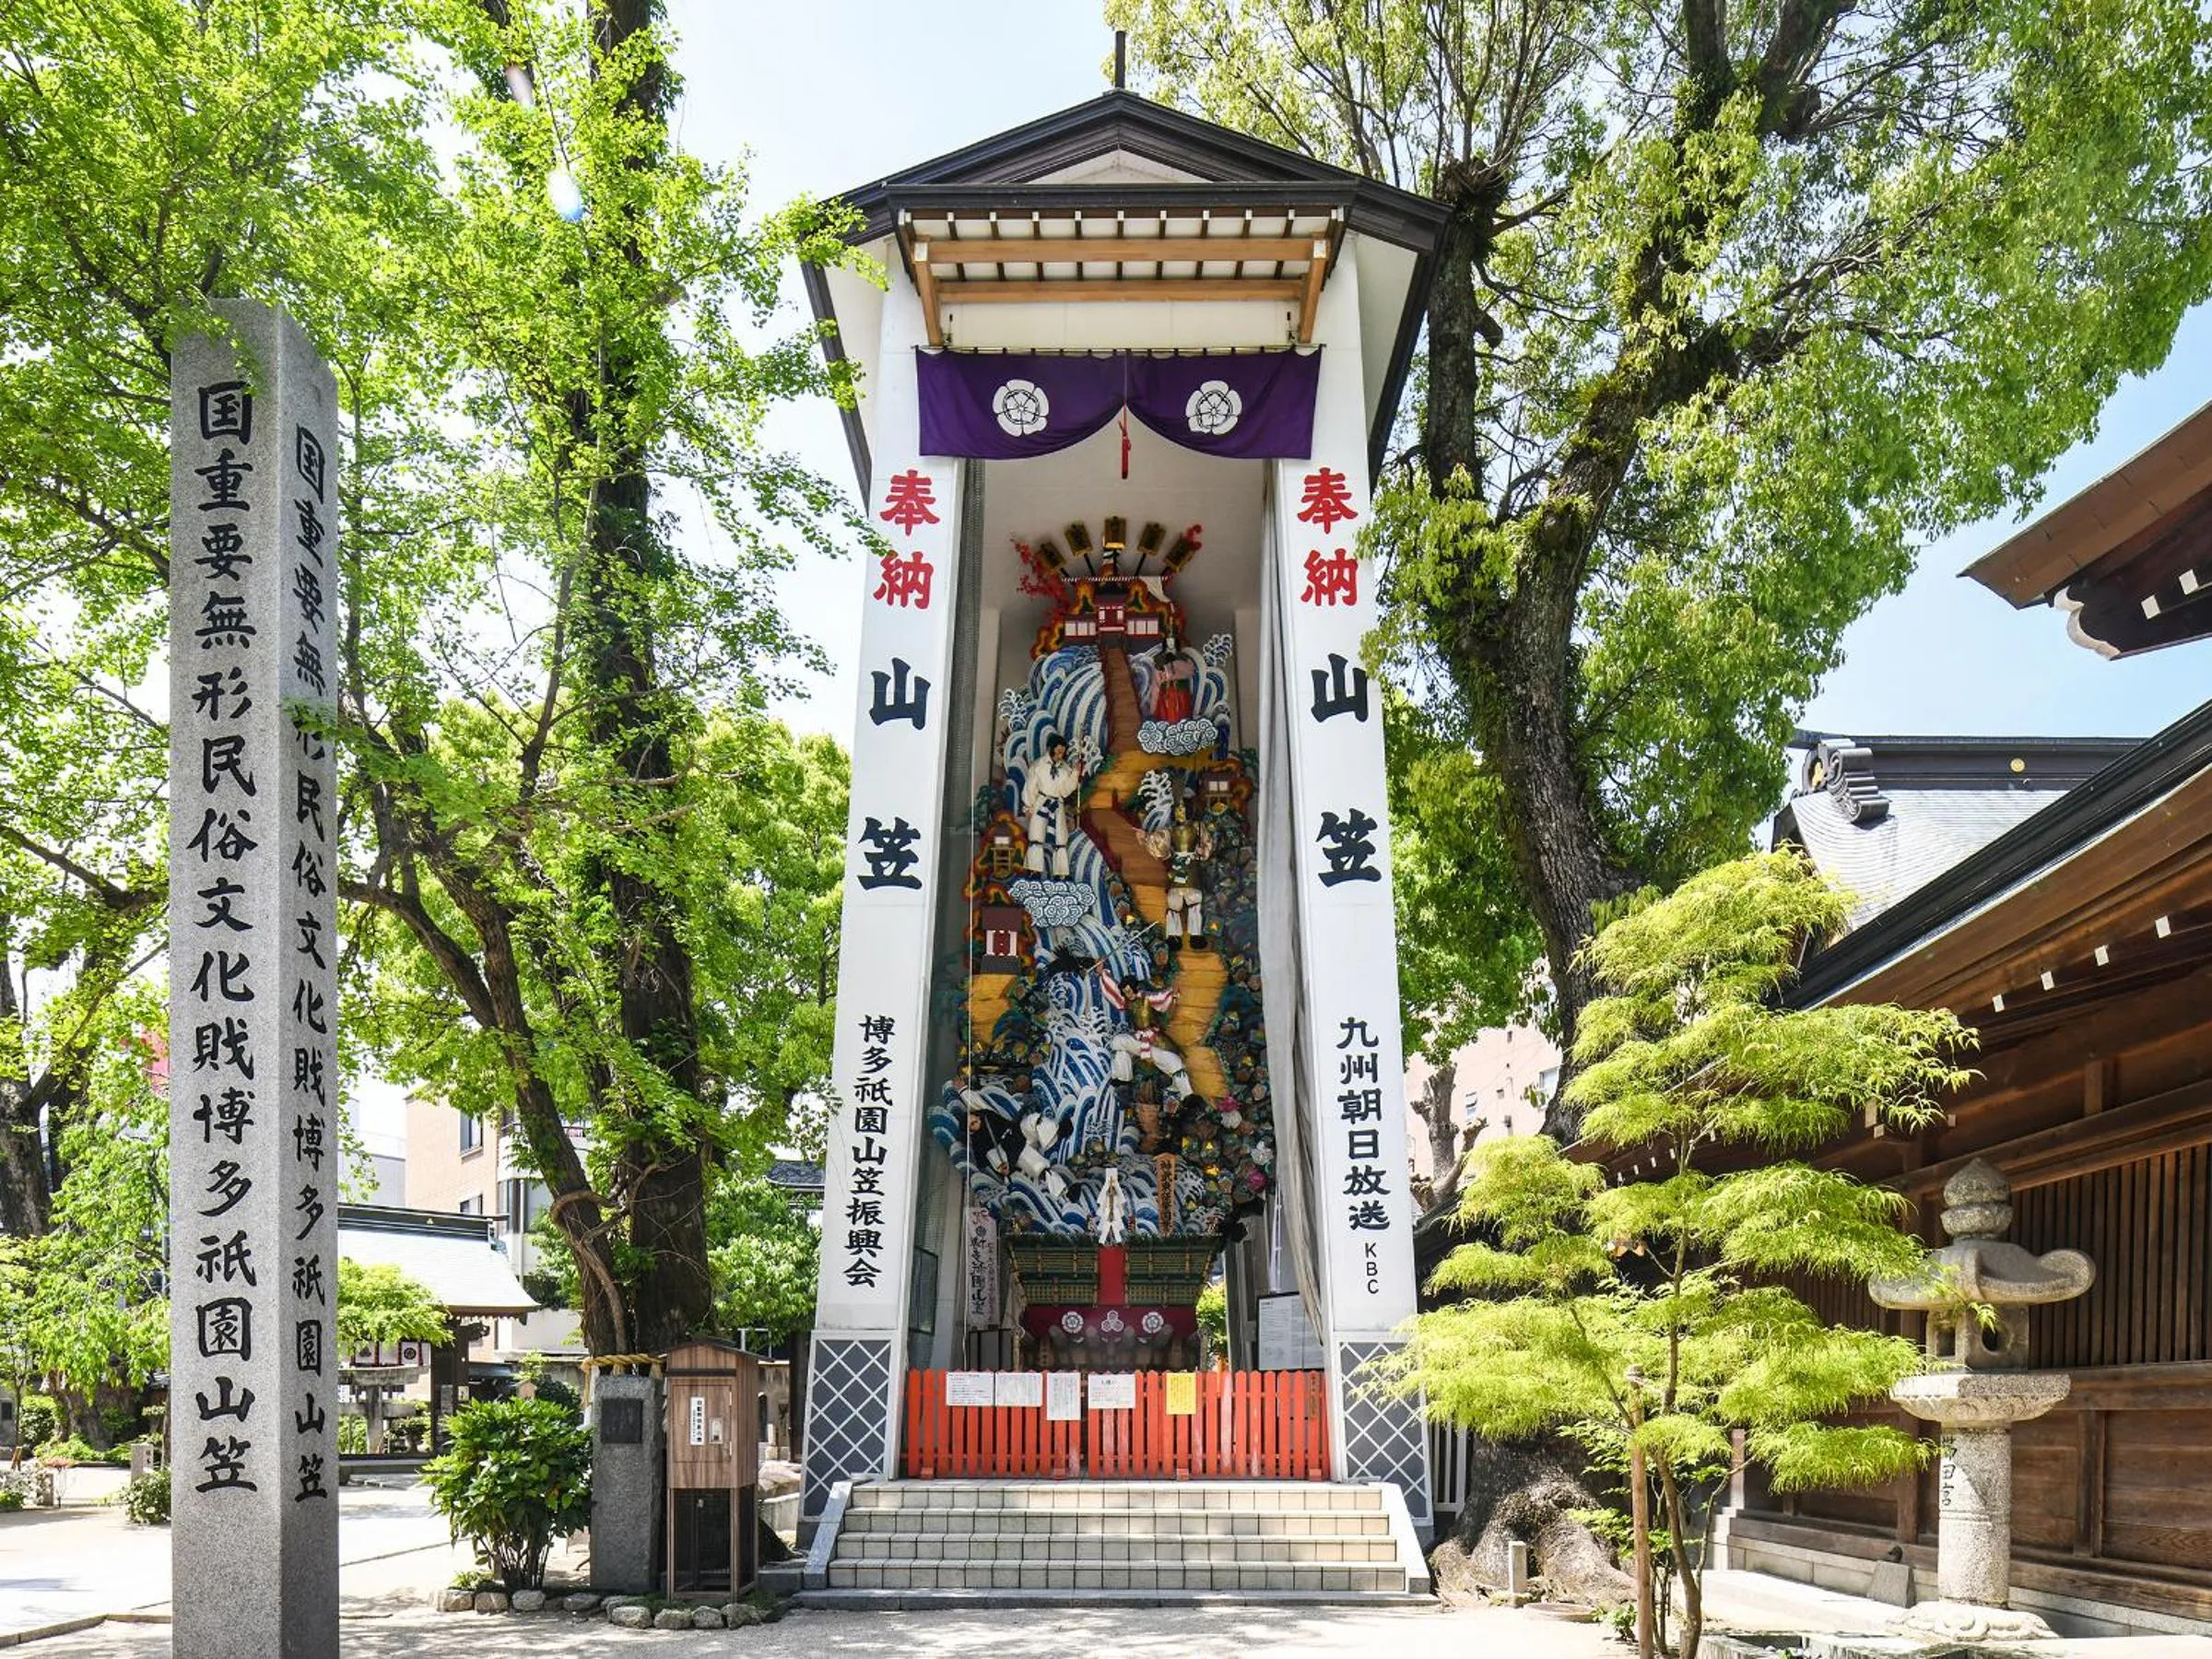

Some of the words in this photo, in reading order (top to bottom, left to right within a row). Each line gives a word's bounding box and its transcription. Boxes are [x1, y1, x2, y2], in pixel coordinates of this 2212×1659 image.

[874, 470, 940, 609] 奉納
[1297, 467, 1359, 606] 奉納
[857, 657, 931, 890] 山笠
[1311, 653, 1382, 888] 山笠
[843, 1015, 895, 1288] 博多祇園山笠振興会
[1335, 1017, 1391, 1230] 九州朝日放送
[1365, 1242, 1380, 1294] KBC
